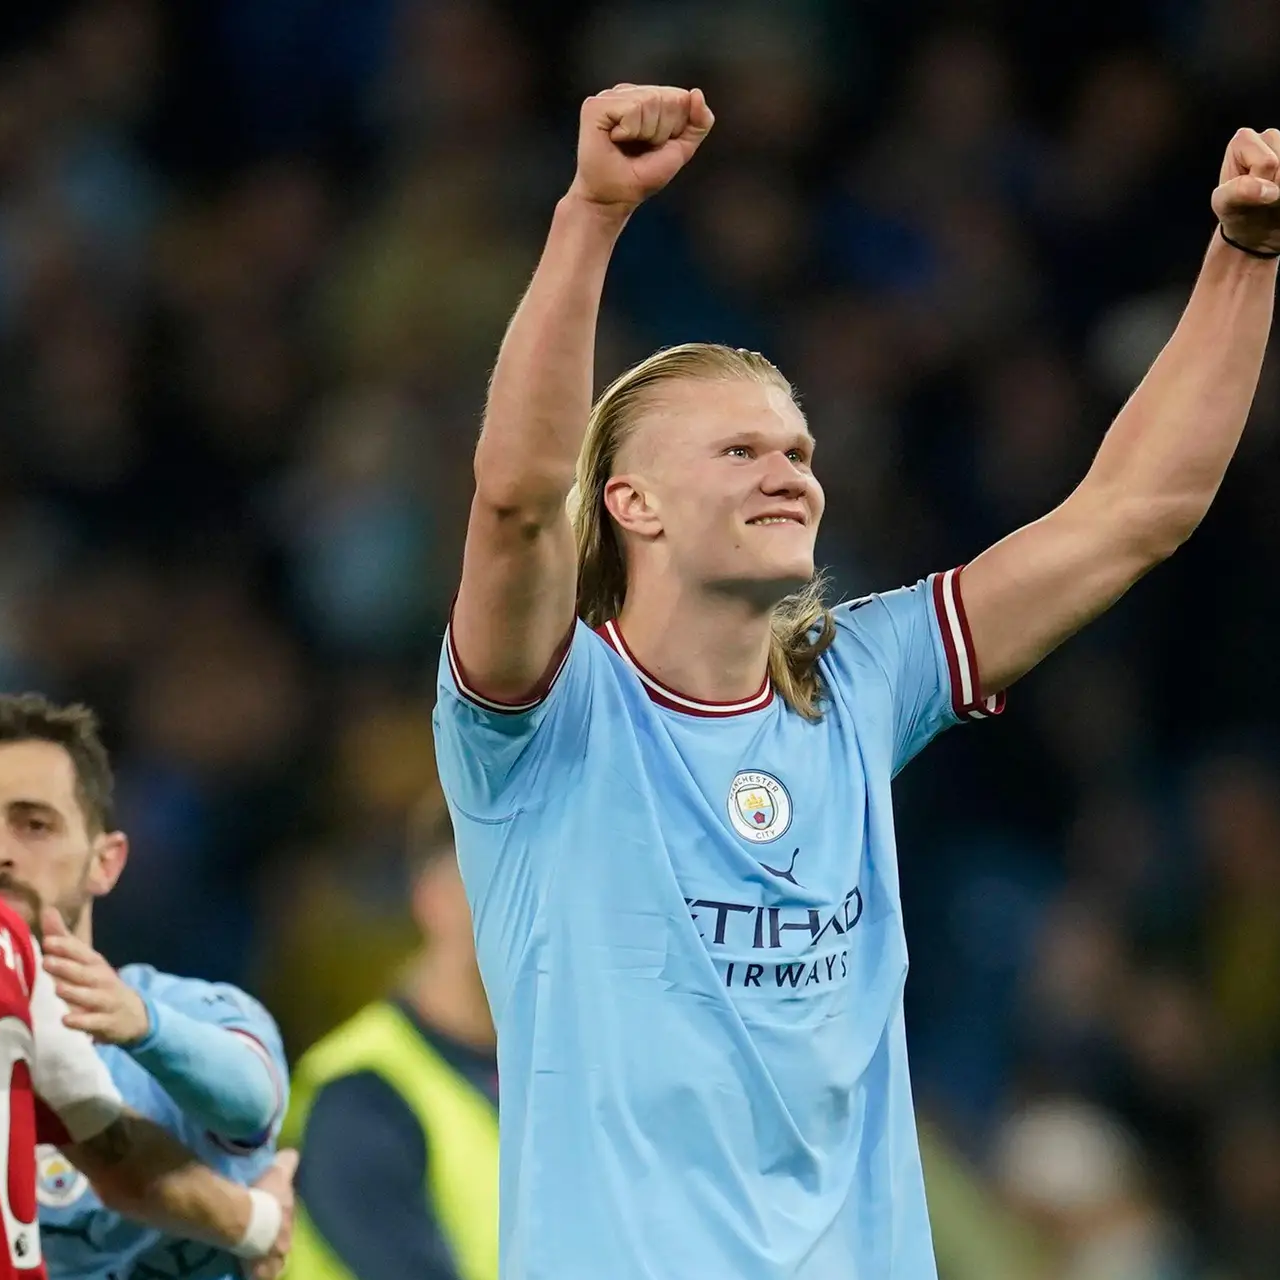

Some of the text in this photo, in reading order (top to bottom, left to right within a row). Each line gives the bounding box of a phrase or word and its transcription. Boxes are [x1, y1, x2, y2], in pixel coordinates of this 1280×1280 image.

[730, 775, 779, 800] MANCHESTER
[756, 829, 776, 839] CITY
[726, 951, 848, 988] IRWAYS
